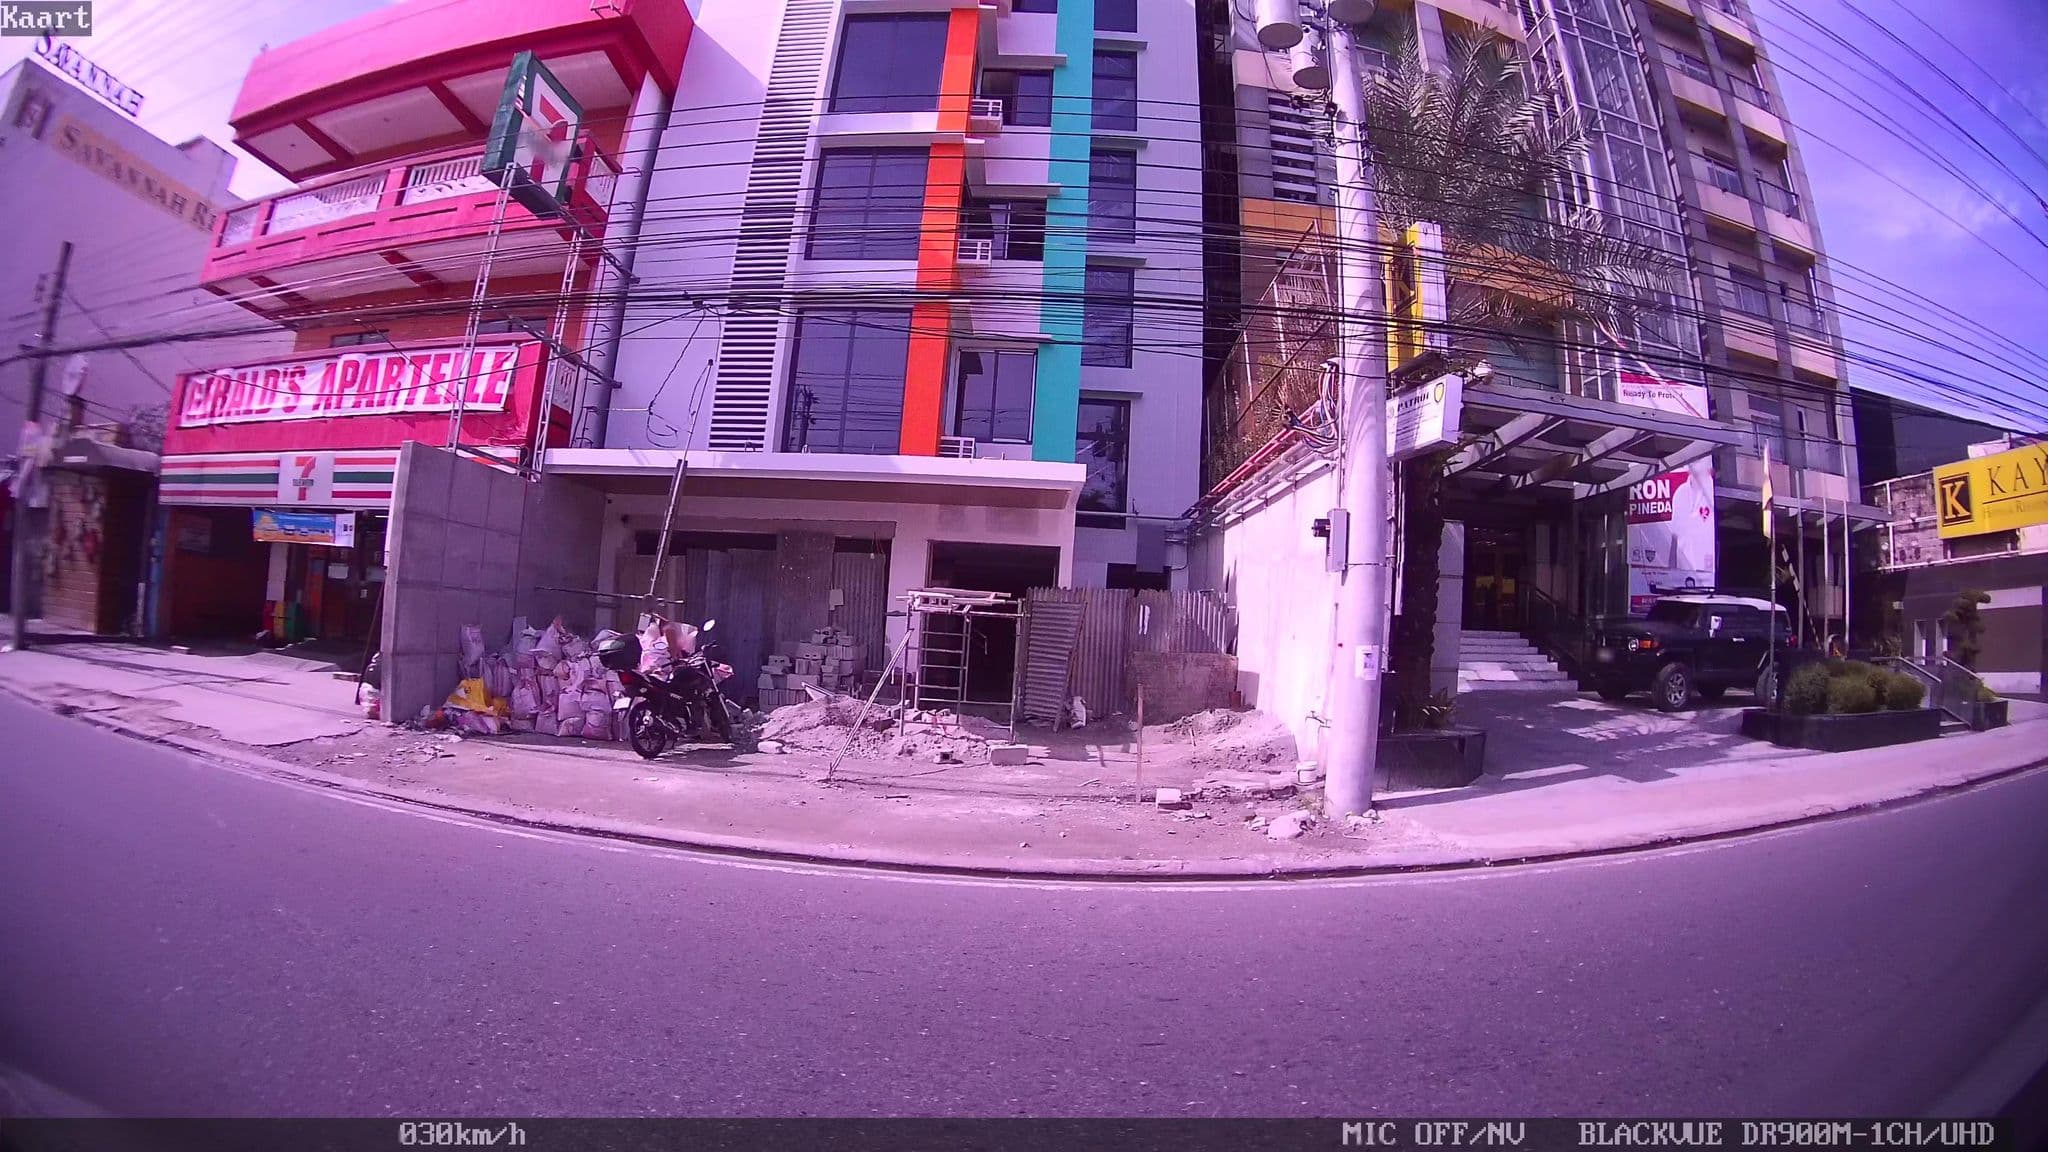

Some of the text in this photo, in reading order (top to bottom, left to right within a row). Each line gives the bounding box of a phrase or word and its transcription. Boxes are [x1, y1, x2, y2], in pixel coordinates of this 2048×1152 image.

[312, 350, 515, 411] APARTELLE
[1623, 389, 1645, 400] Ready
[1658, 391, 1683, 399] Prott
[1629, 480, 1671, 500] RON
[1942, 480, 1971, 519] K
[1629, 501, 1672, 517] PINEDA
